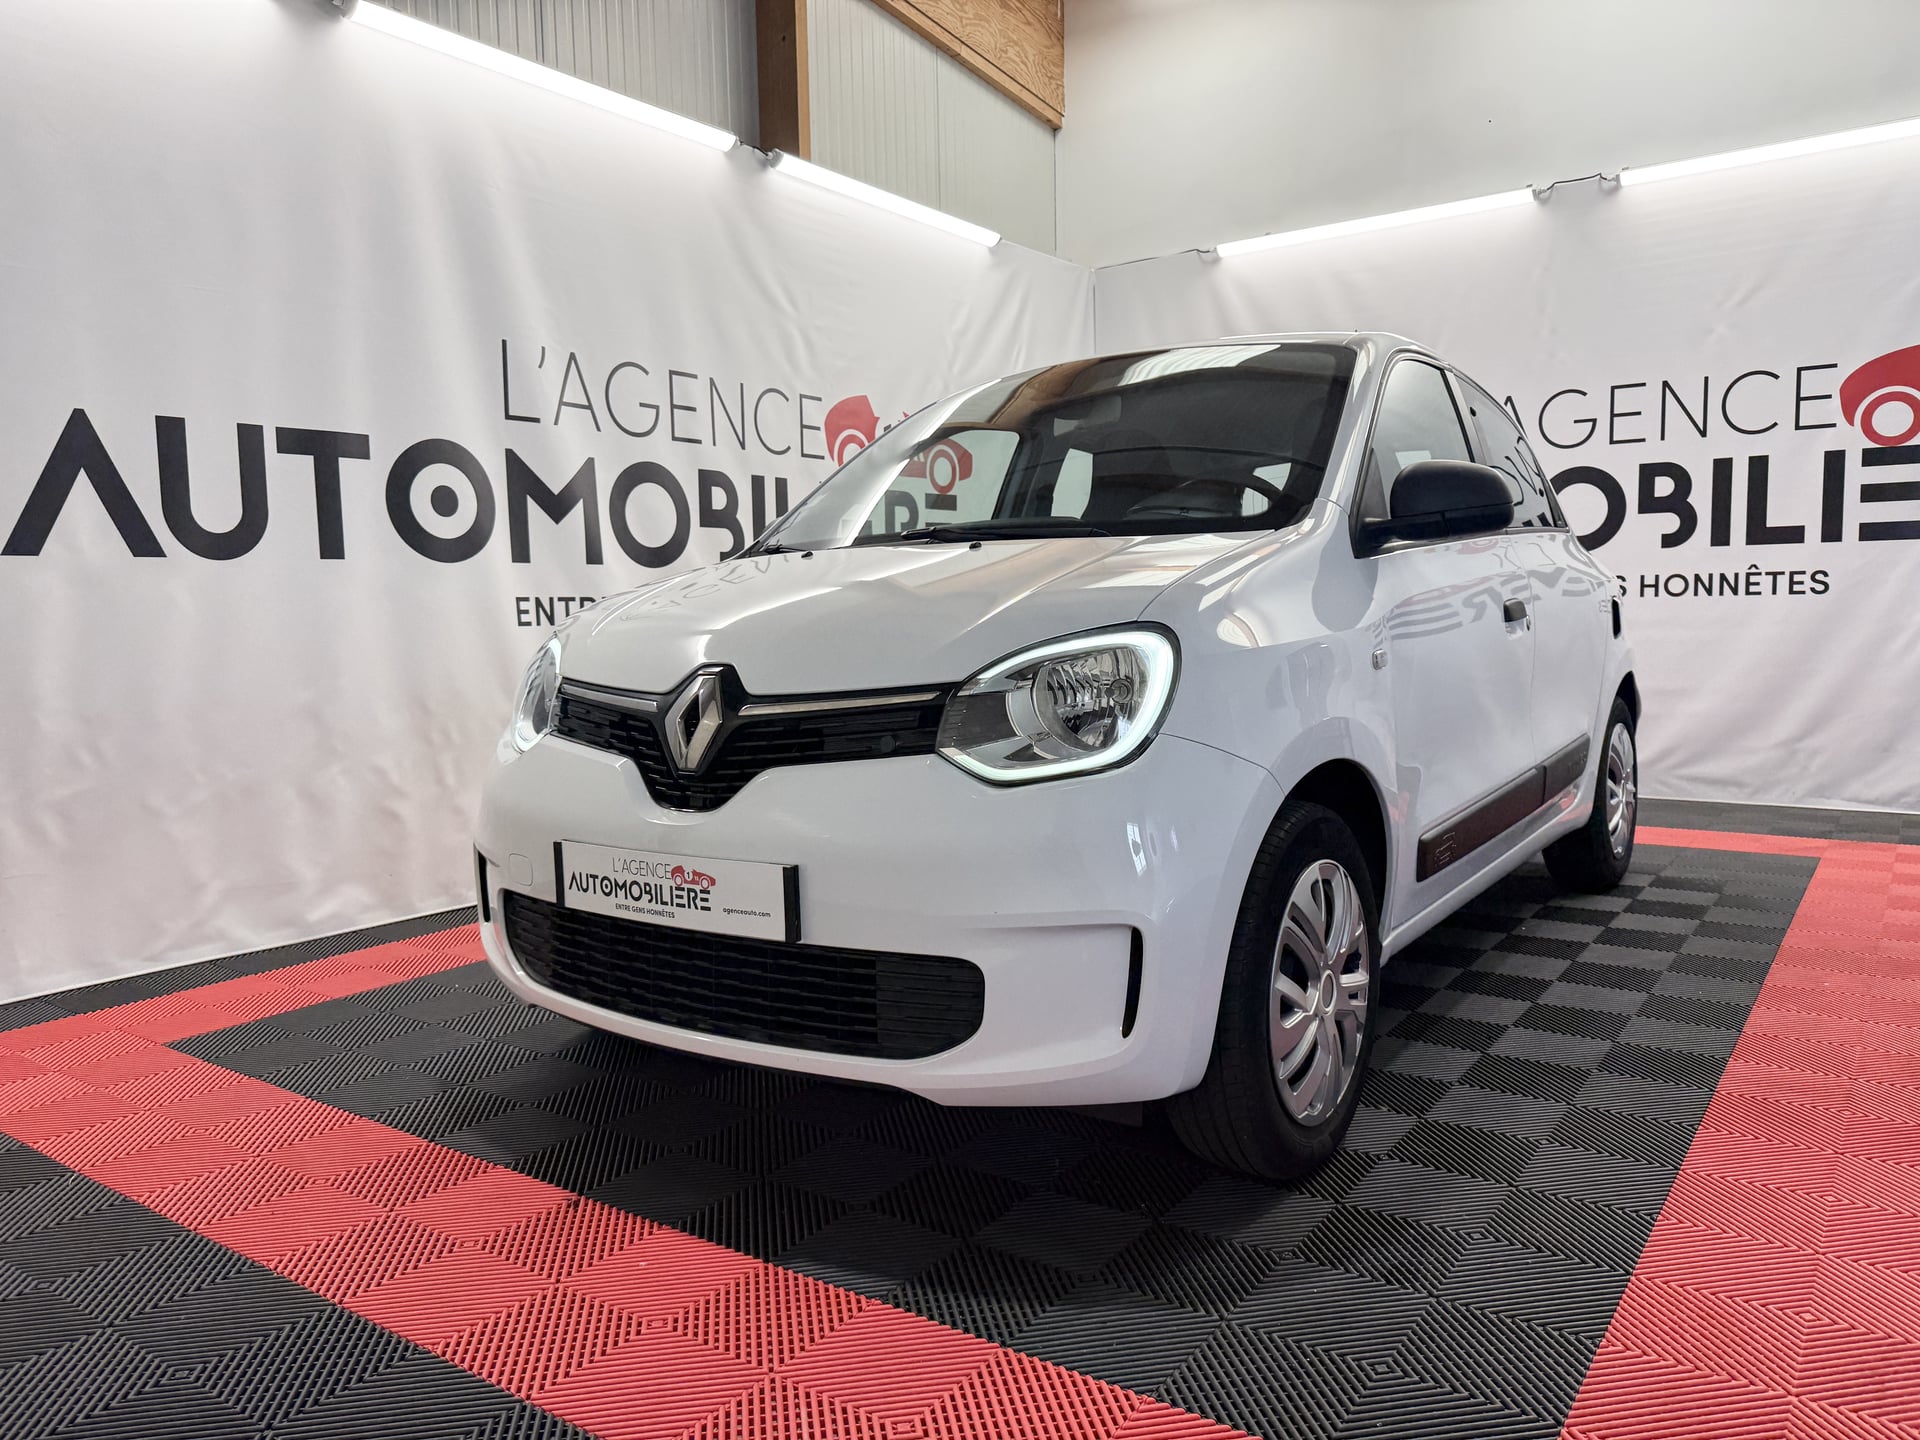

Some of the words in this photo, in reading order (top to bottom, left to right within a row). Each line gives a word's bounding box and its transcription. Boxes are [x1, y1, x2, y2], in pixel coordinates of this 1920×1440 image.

[501, 338, 826, 460] L'AGENCE
[1639, 564, 1830, 598] HONNÊTES
[515, 596, 607, 626] ENT
[612, 857, 671, 880] L'AGENCE
[615, 903, 631, 911] ENTRE
[631, 905, 646, 914] GENS
[646, 908, 675, 918] HONNÊTES
[722, 907, 771, 917] agenceauto.com
